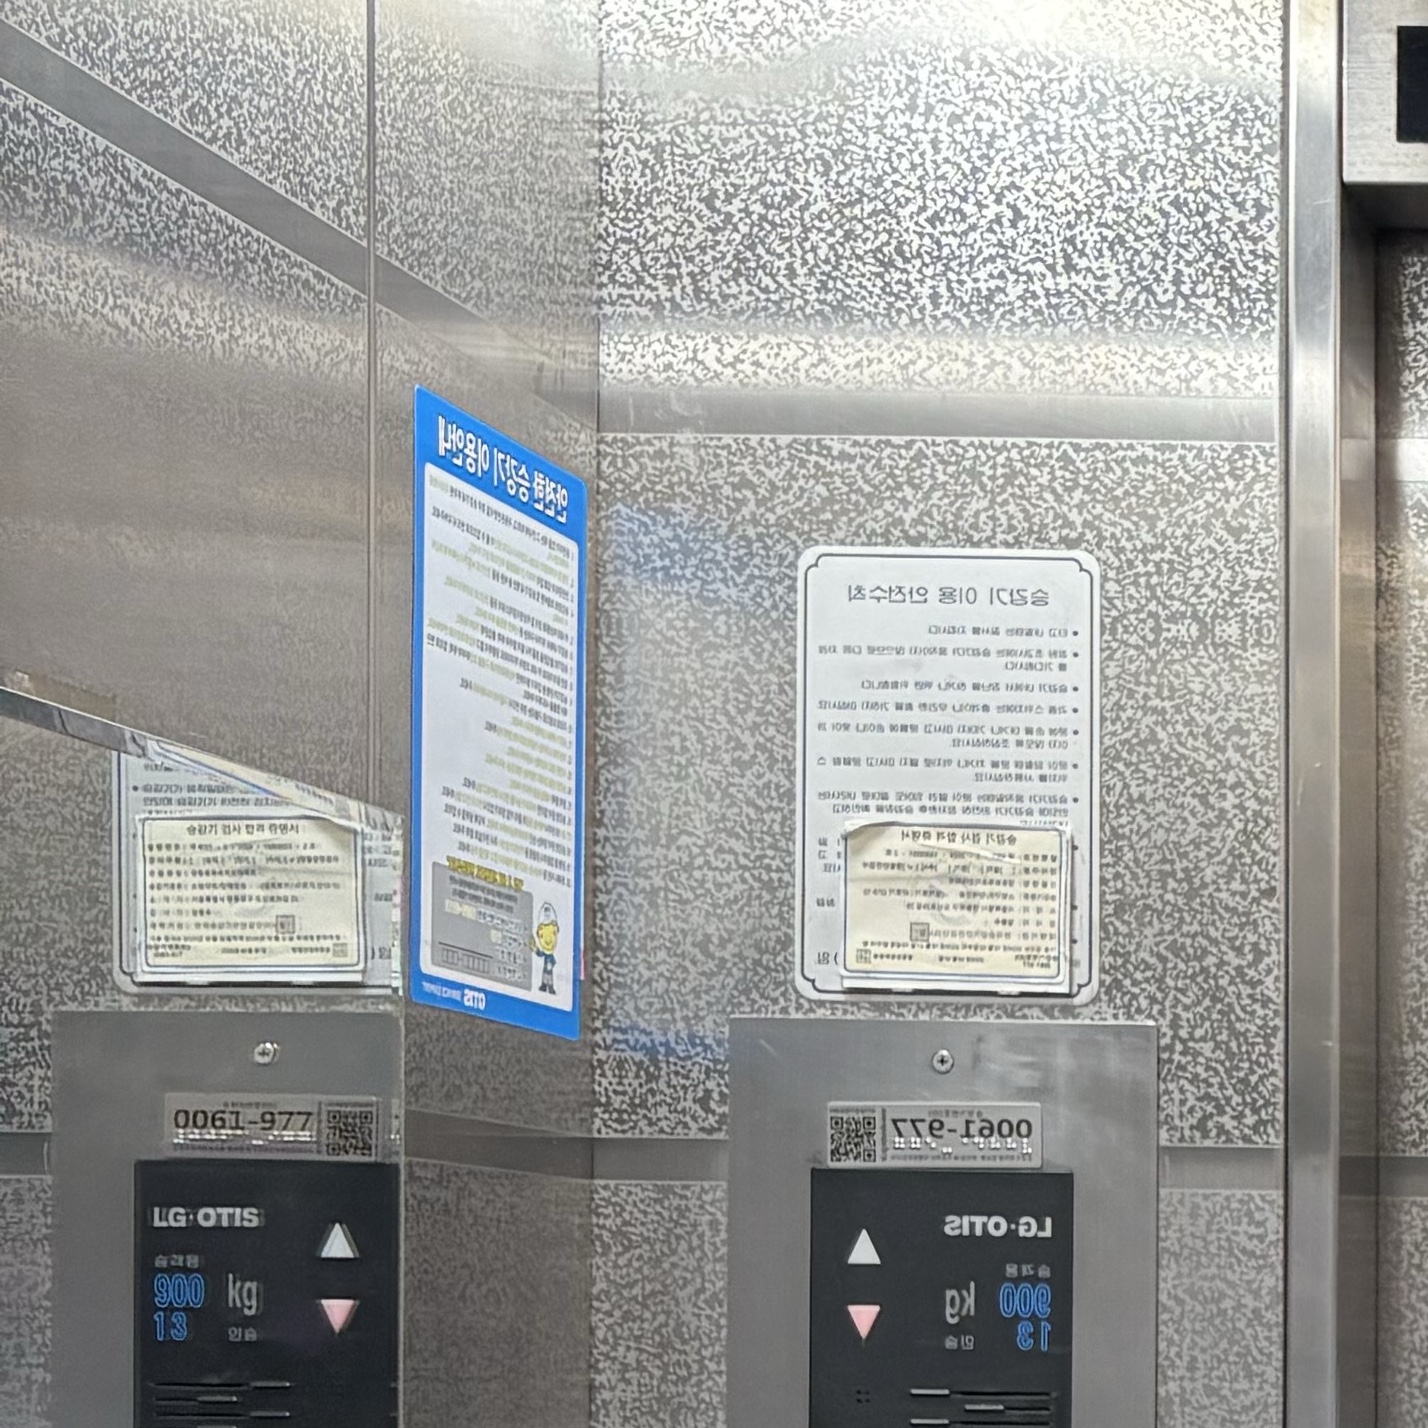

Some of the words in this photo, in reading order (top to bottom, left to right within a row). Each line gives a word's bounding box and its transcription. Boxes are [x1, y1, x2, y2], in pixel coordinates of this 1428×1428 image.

[173, 1111, 314, 1132] 0061-977
[154, 1273, 205, 1309] 900
[228, 1273, 258, 1316] kg
[154, 1311, 187, 1341] 13
